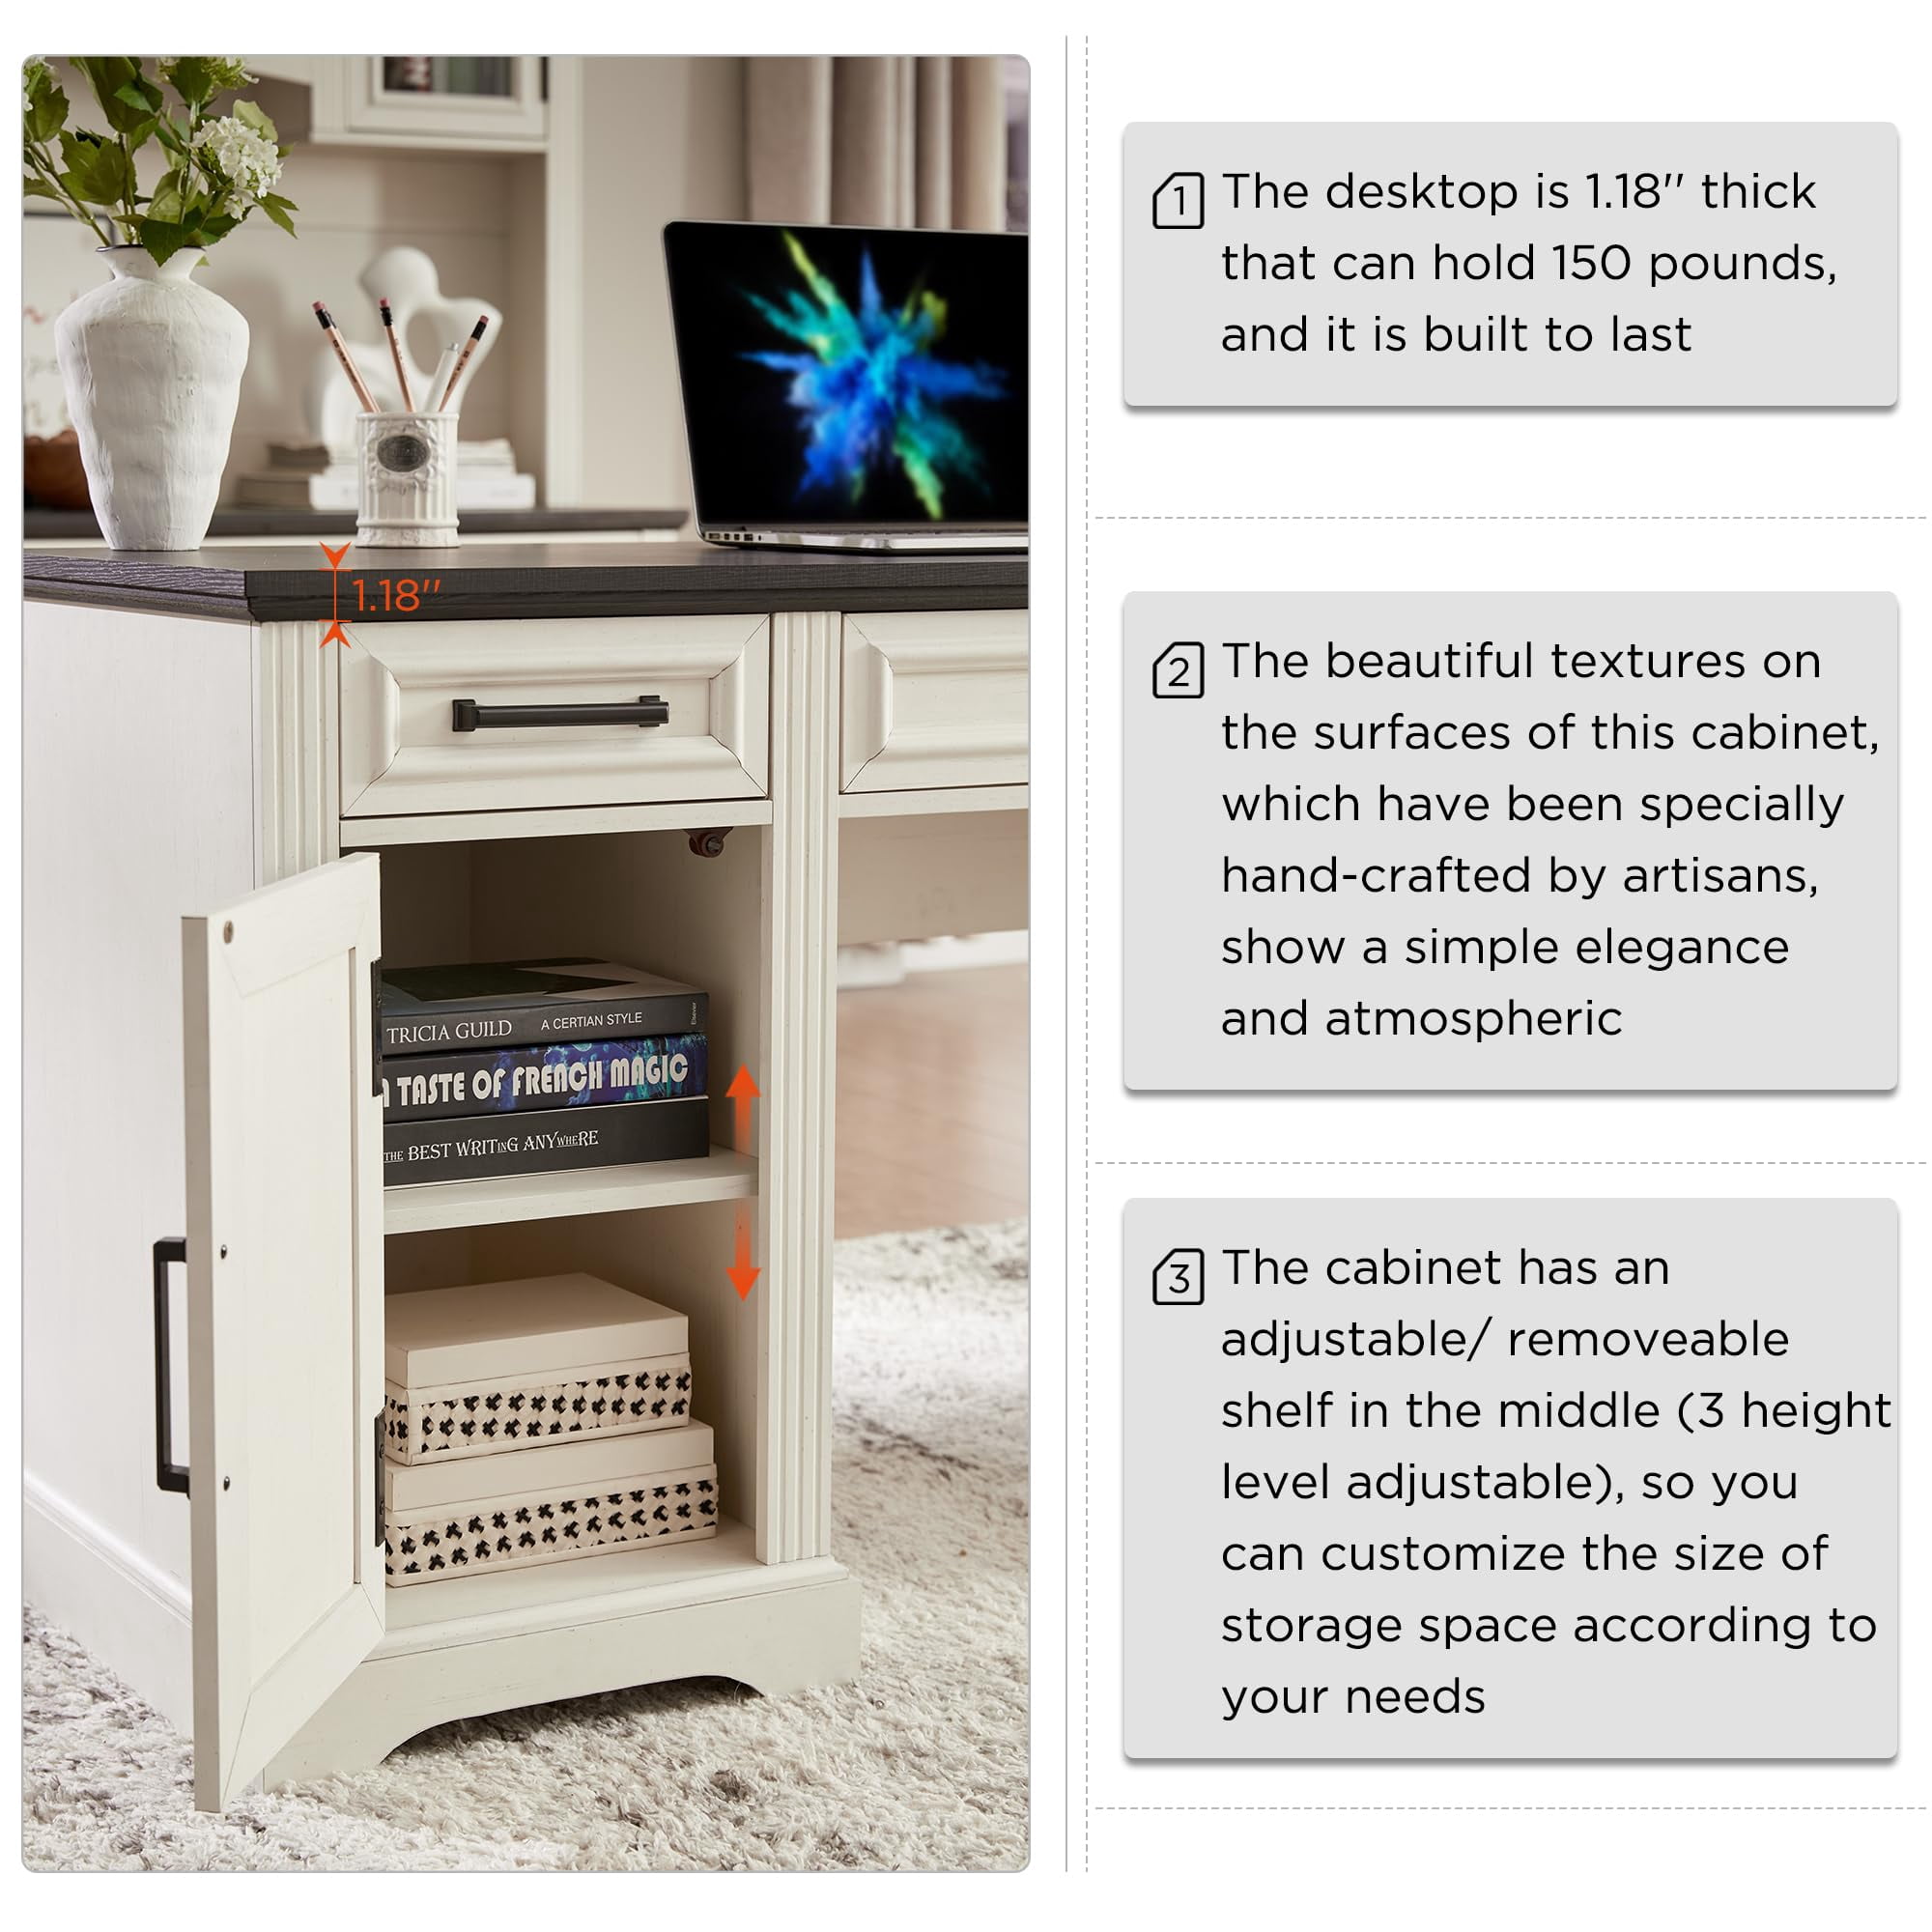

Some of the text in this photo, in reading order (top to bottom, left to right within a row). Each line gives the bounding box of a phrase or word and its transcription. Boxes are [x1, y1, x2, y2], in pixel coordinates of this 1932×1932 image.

[386, 1020, 513, 1044] TRICIA GUILD
[541, 1011, 643, 1031] A CERTIAN STYLE
[396, 1071, 466, 1107] TASTE
[471, 1067, 507, 1100] OF
[512, 1060, 604, 1097] FRENCH
[611, 1053, 689, 1088] MAGIC
[408, 1142, 452, 1161] BEST
